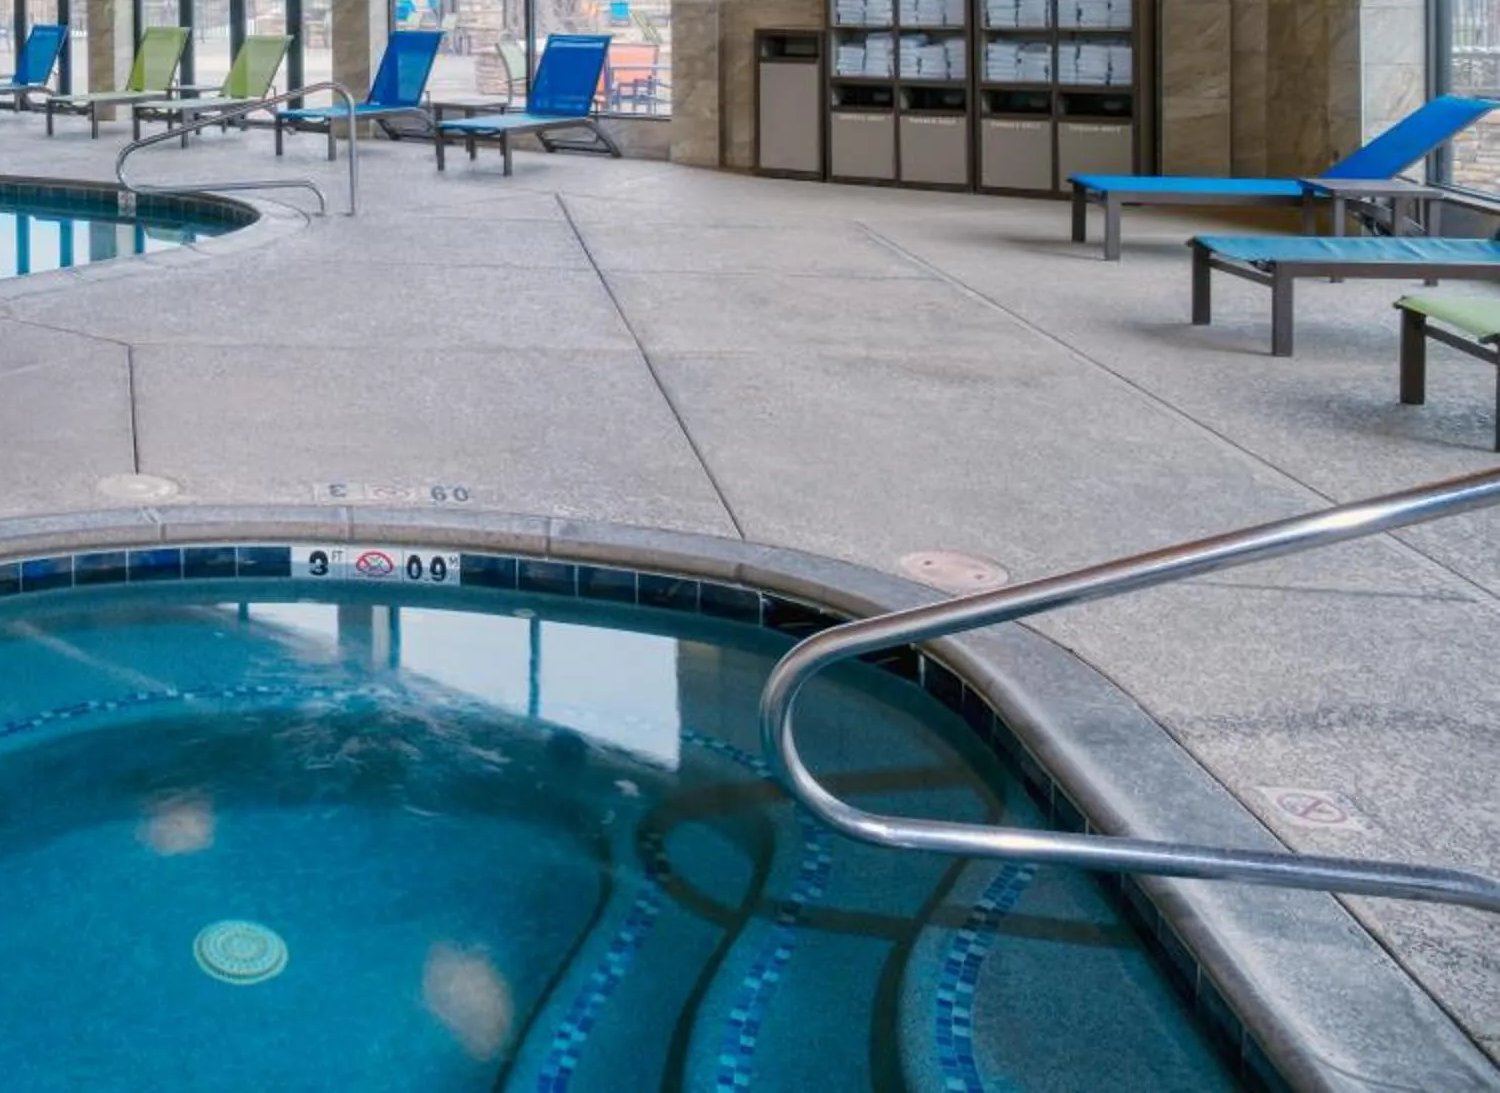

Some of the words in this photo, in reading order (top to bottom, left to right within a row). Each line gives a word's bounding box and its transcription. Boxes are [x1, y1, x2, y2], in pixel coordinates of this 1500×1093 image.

[329, 483, 347, 498] 3
[308, 550, 329, 576] 3
[331, 550, 344, 563] FT
